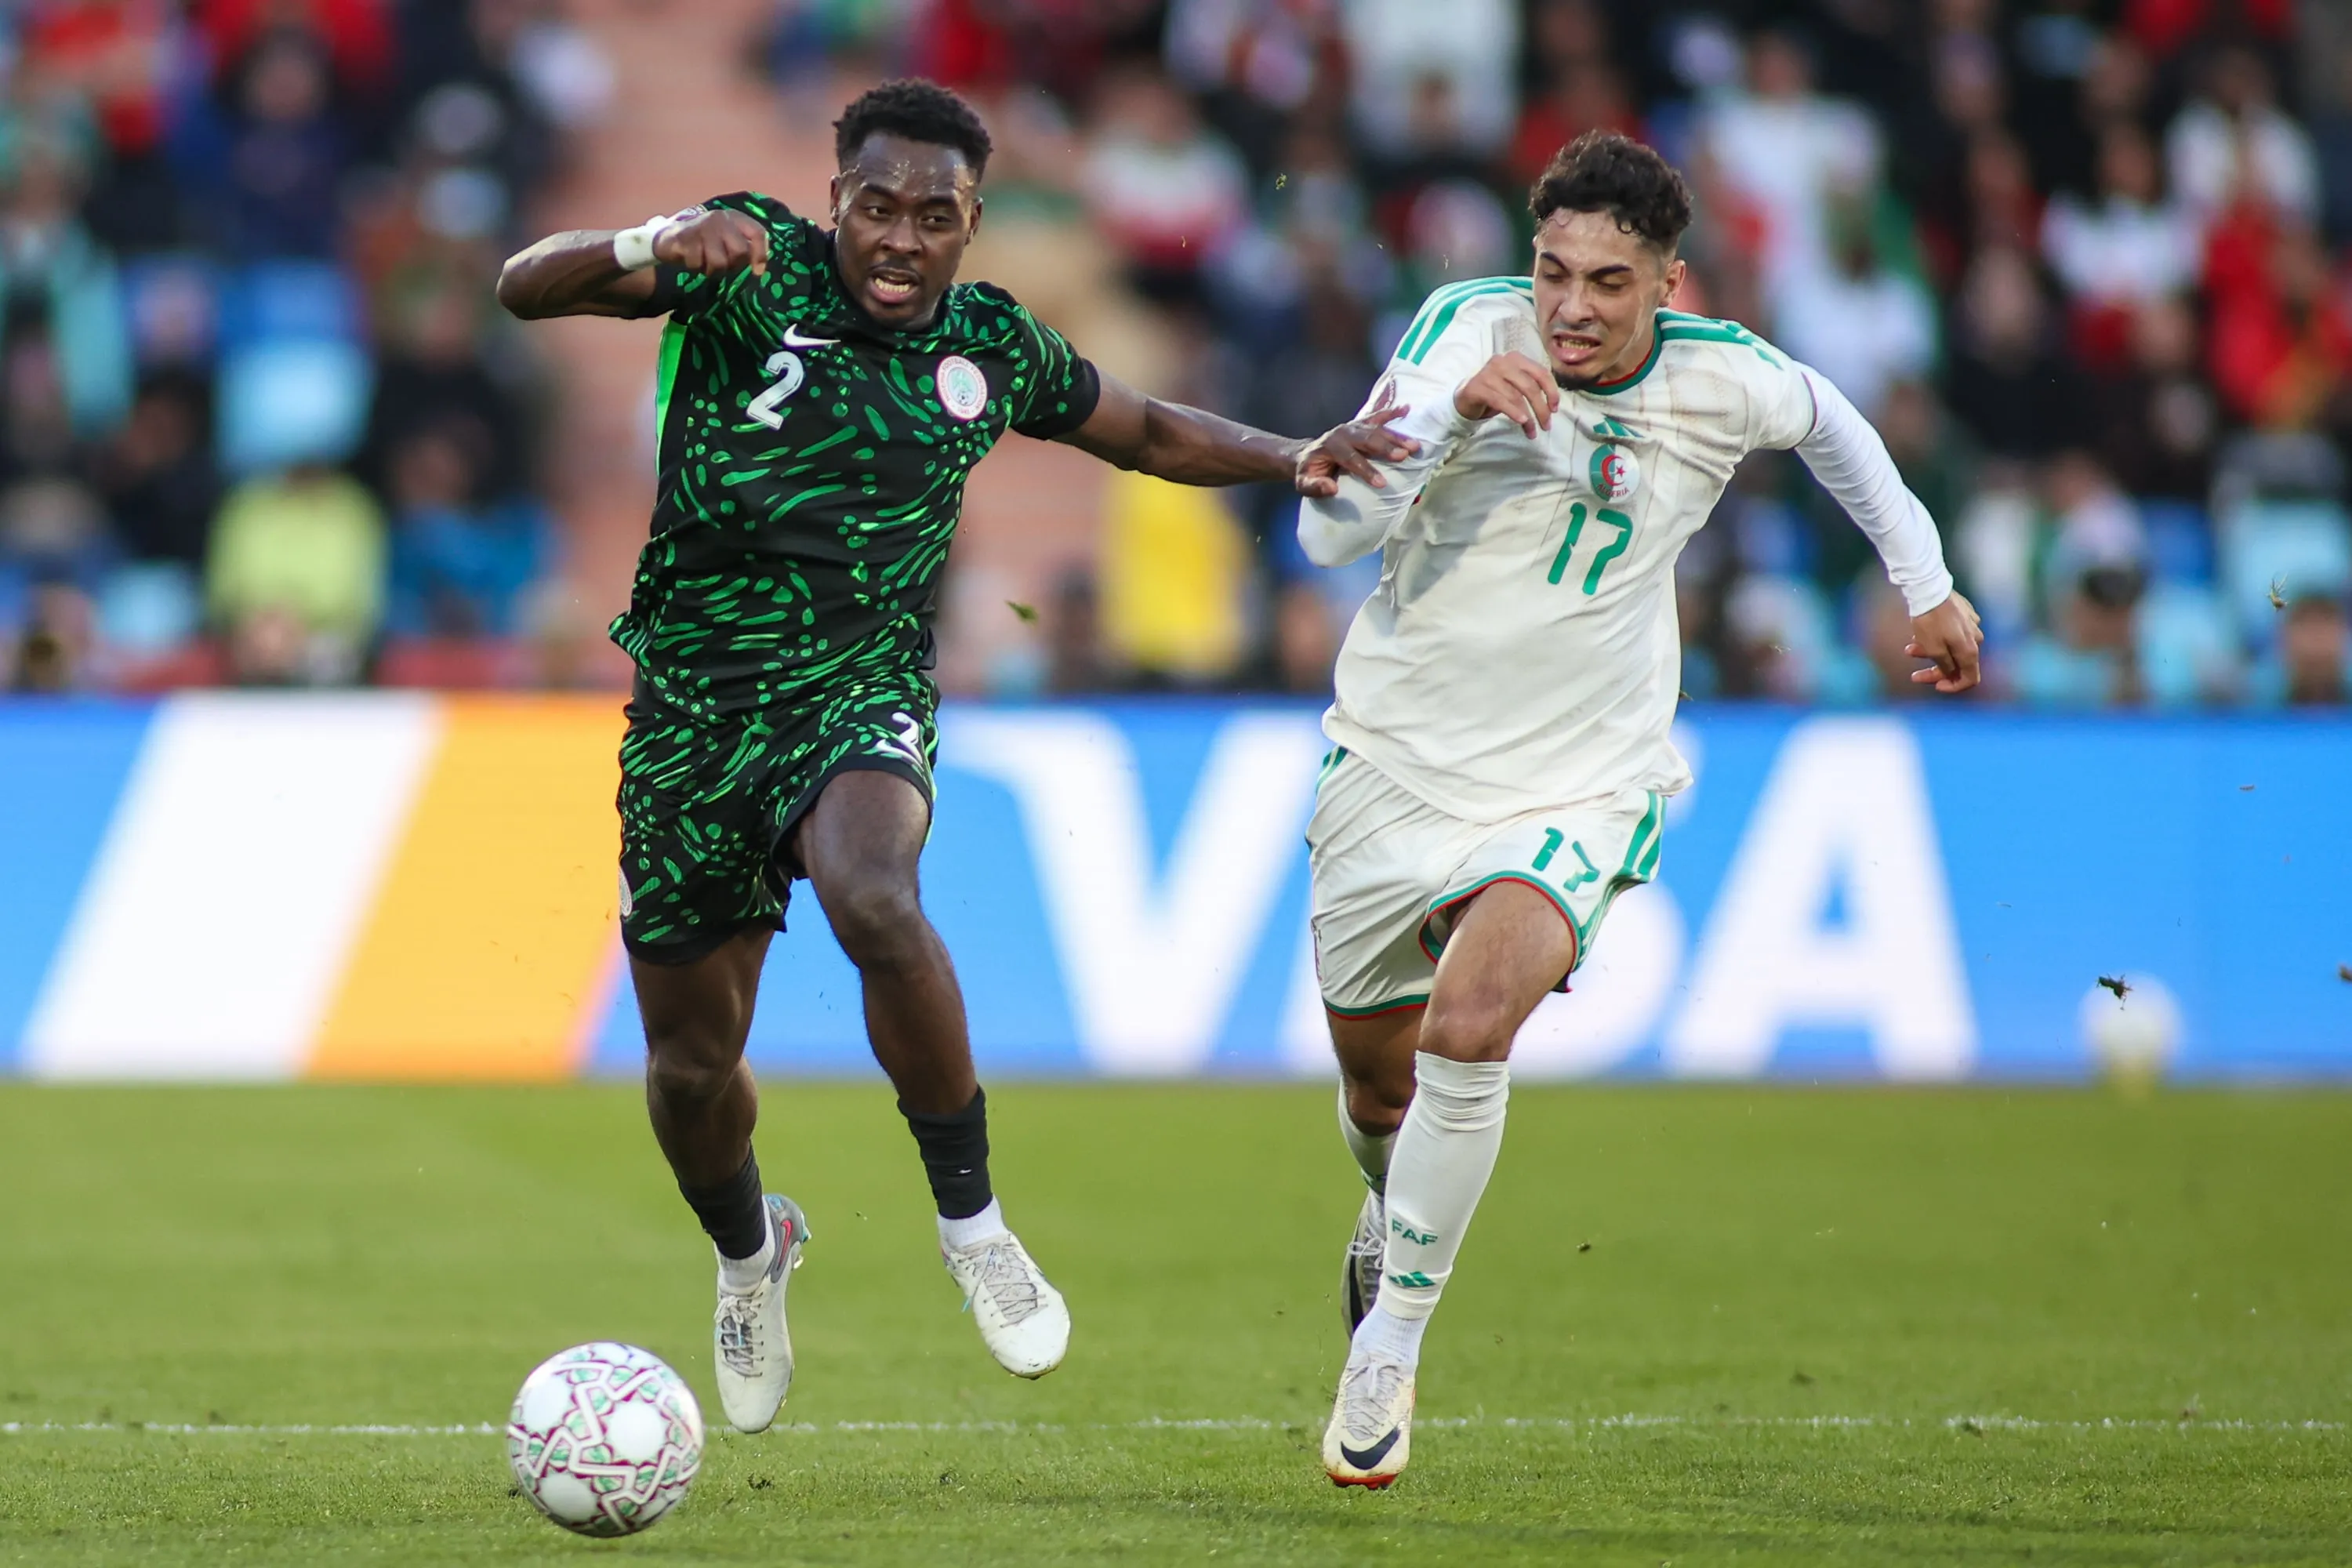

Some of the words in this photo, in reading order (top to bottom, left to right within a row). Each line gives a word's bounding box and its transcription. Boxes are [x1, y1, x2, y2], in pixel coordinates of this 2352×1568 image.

[746, 350, 804, 430] 2
[1596, 483, 1630, 497] ALGERIA
[1548, 502, 1633, 596] 17
[1531, 826, 1600, 892] 17
[936, 710, 1980, 1082] VA
[1392, 1218, 1438, 1245] FAF
